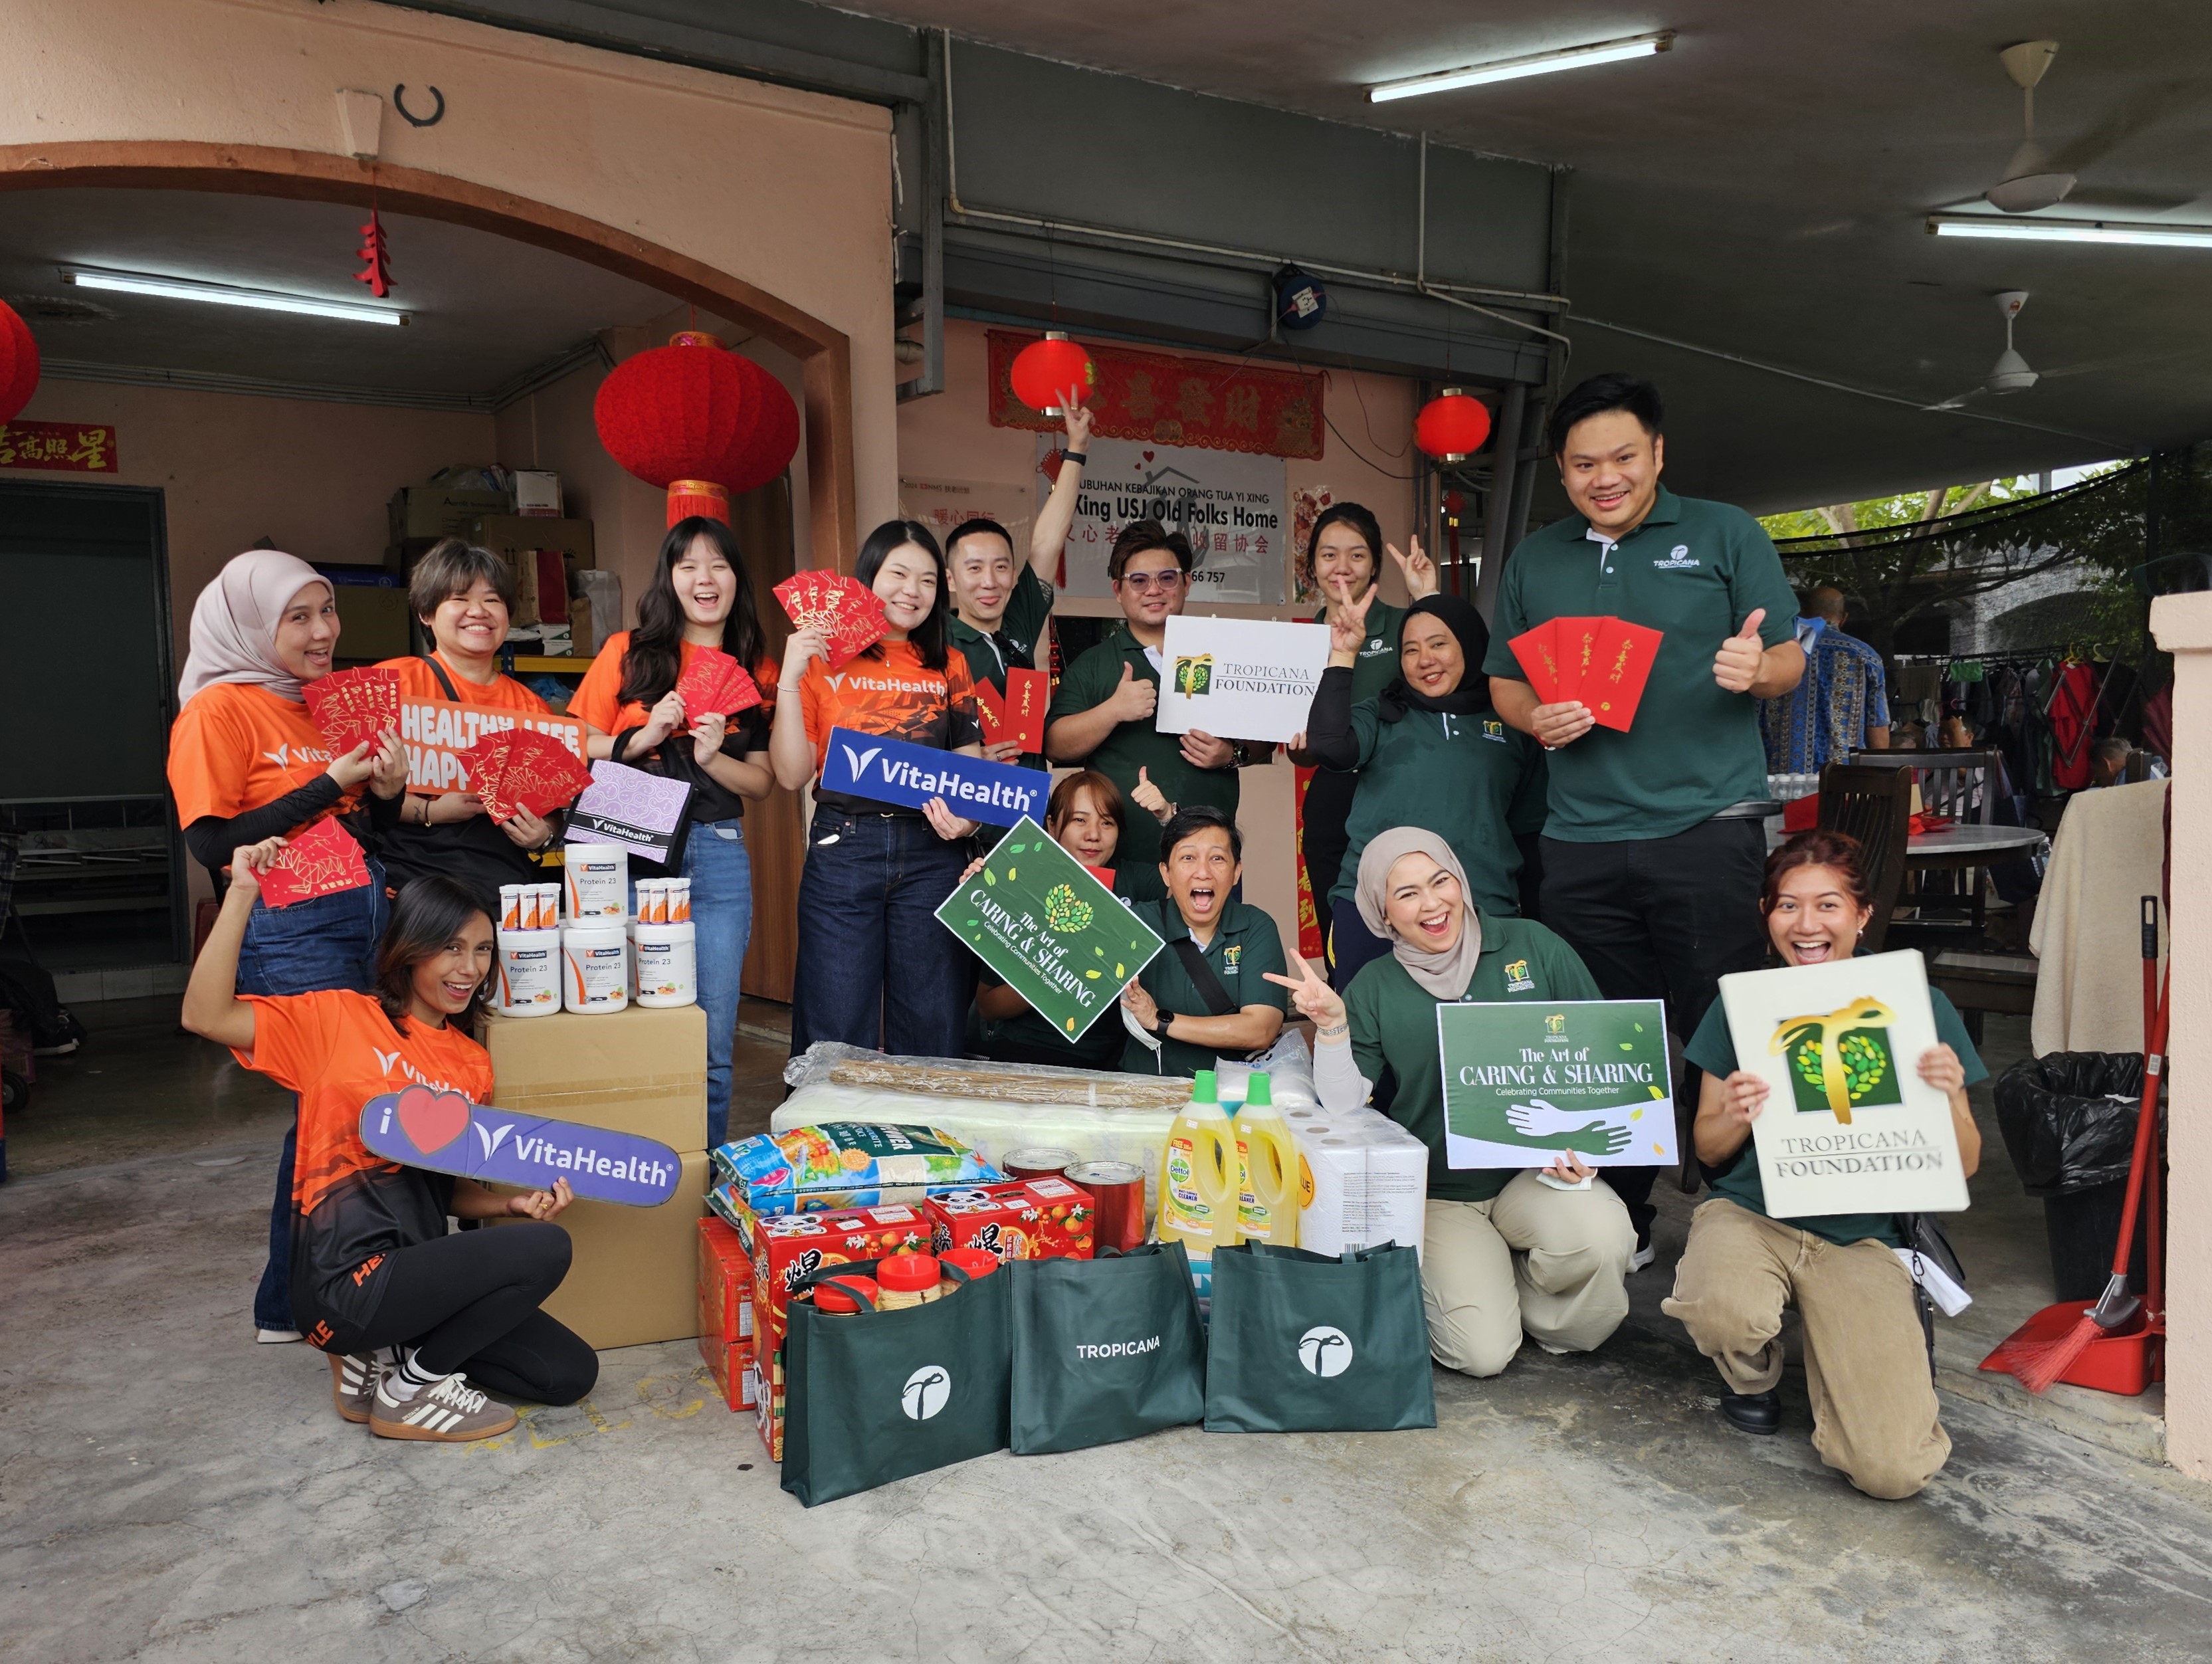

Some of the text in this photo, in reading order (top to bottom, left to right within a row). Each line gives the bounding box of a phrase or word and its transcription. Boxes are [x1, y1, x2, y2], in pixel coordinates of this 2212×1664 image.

[1125, 483, 1175, 496] KEBAJIKAN
[1178, 487, 1213, 500] ORANG
[1215, 490, 1234, 501] TUA
[1236, 492, 1245, 502] YI
[1247, 493, 1270, 504] XING
[1117, 497, 1147, 520] USJ
[1152, 499, 1181, 522] Old
[1187, 502, 1228, 526] Folks
[1233, 506, 1278, 529] Home
[1653, 558, 1700, 567] TROPICANA
[1207, 572, 1225, 583] 757
[1223, 663, 1309, 680] TROPICANA
[849, 676, 946, 697] VitaHealth
[1215, 678, 1316, 696] FOUNDATION
[1019, 911, 1069, 958] The Art of
[970, 889, 1096, 1008] CARING & SHARING
[983, 921, 1063, 995] Celebrating Communities Together
[1518, 1046, 1590, 1063] The Art of
[1459, 1063, 1653, 1087] CARING & SHARING
[1496, 1086, 1619, 1097] Celebrating Communities Together
[1781, 1129, 1929, 1154] TROPICANA
[1170, 1164, 1189, 1176] Dettol
[1773, 1152, 1944, 1178] FOUNDATION
[1178, 1193, 1198, 1201] CLEANER
[1076, 1335, 1161, 1360] TROPICANA
